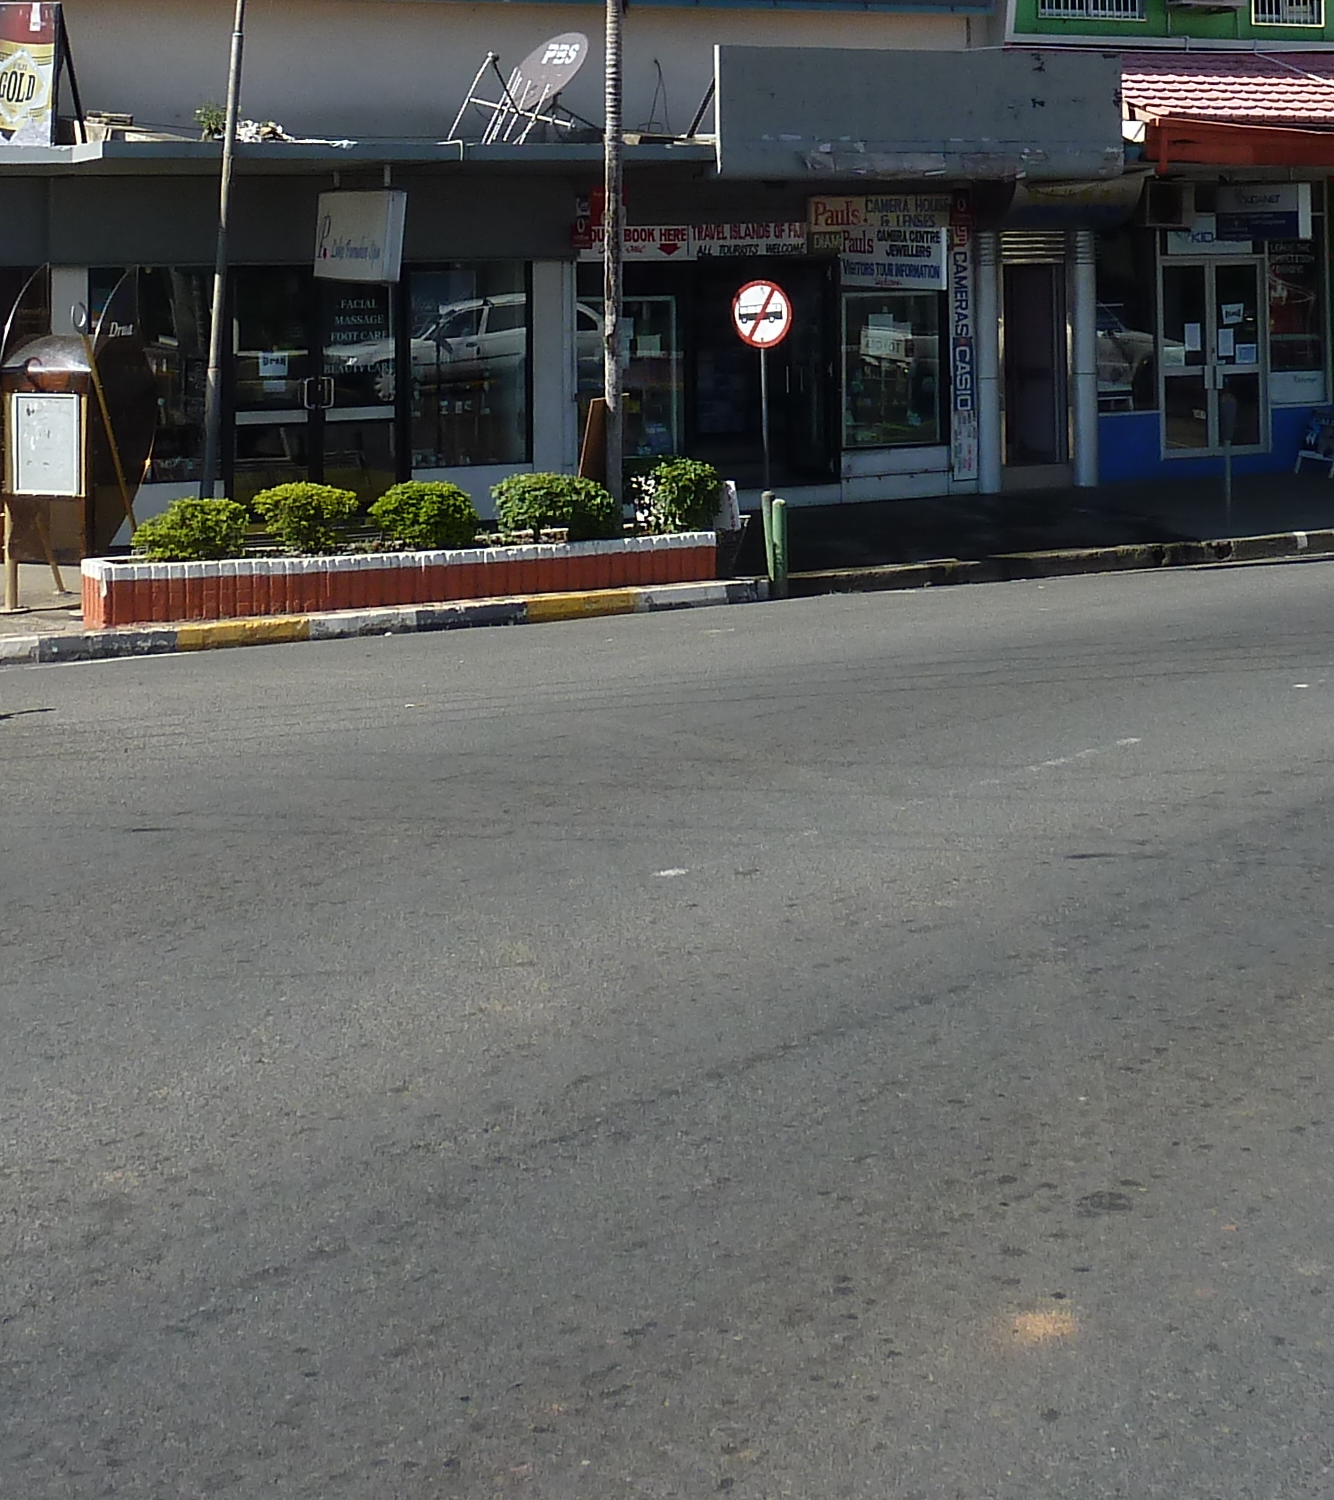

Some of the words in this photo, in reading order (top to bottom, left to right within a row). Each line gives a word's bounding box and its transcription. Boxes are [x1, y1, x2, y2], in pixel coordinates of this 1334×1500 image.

[0, 70, 36, 103] GOLD
[813, 201, 860, 227] Paul's
[624, 228, 656, 243] BOOK
[659, 228, 687, 242] HERE
[692, 223, 727, 241] TRAVEL
[729, 222, 771, 240] ISLANDS
[774, 222, 785, 239] OF
[697, 244, 713, 255] ALL
[719, 243, 759, 255] TOURISTS
[766, 243, 806, 254] WELCOME
[885, 245, 931, 257] JEWELLERS
[894, 263, 940, 278] INFORMATION
[953, 251, 969, 337] CAMERAS
[340, 299, 378, 309] FACIAL
[334, 314, 384, 325] MASSAGE
[330, 331, 359, 341] FOOT
[954, 346, 971, 411] CASIO
